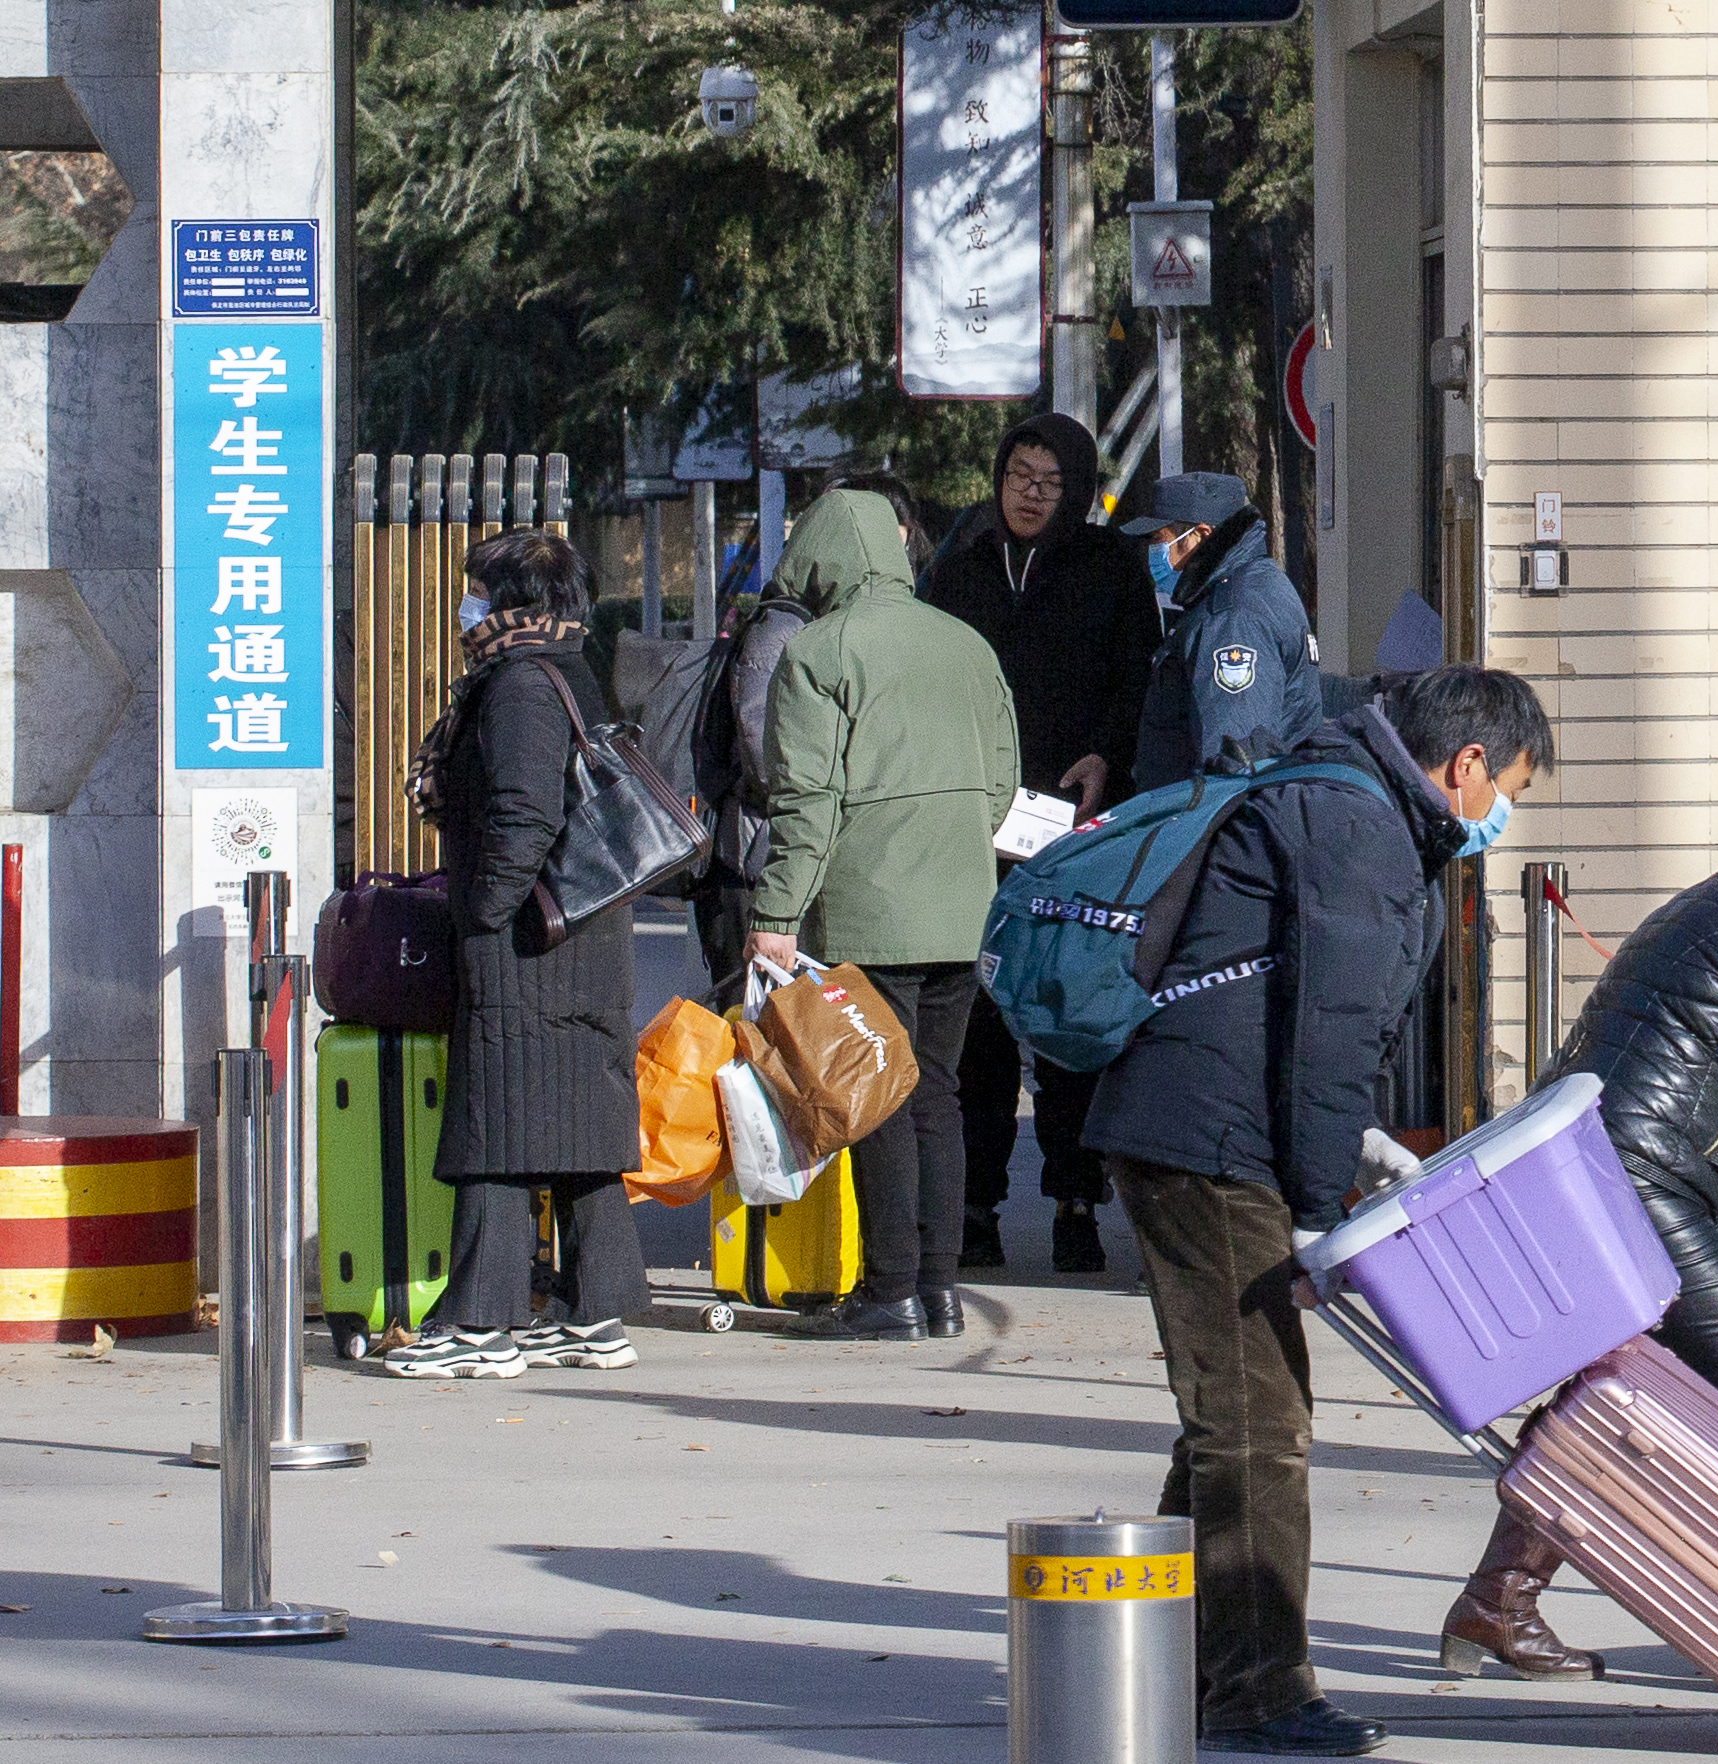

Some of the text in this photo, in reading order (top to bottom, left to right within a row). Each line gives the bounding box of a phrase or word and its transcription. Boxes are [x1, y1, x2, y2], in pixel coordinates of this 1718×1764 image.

[195, 229, 294, 242] 门前三包责任牌
[185, 248, 307, 261] 包卫生 包秩序 包绿化
[207, 346, 290, 752] 学生专用通道
[1062, 1559, 1181, 1595] 河北大学
